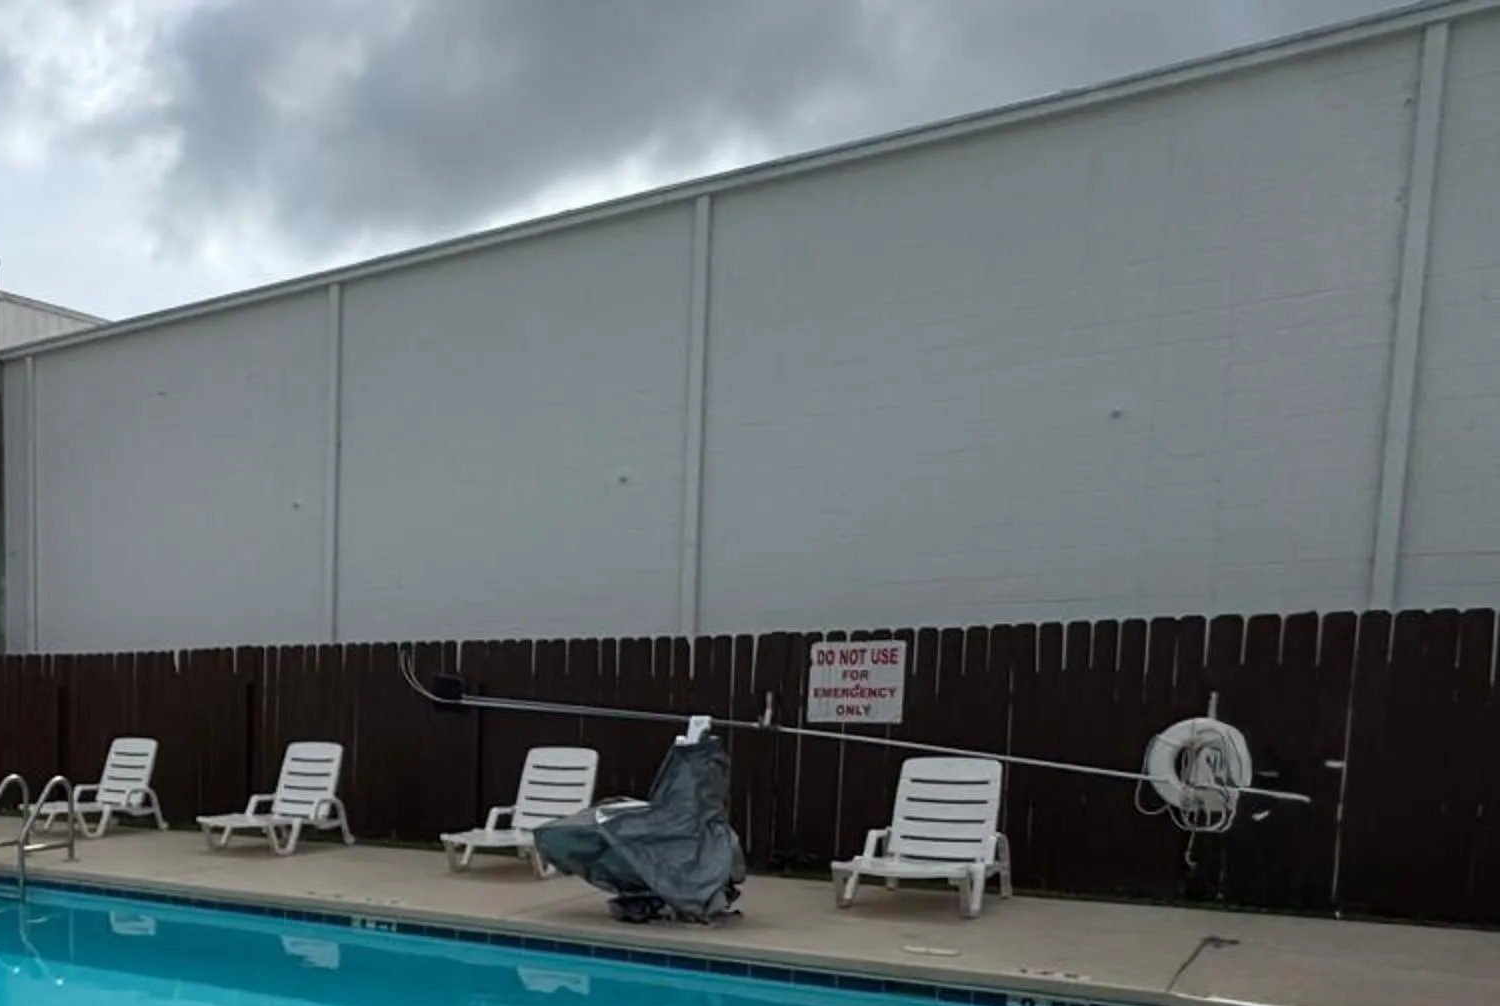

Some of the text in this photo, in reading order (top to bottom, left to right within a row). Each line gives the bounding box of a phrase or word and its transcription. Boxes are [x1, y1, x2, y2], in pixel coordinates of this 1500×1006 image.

[816, 647, 899, 665] DO NOT USE
[841, 669, 869, 681] FOR
[813, 686, 897, 698] EMERGENCY
[835, 704, 872, 716] ONLY
